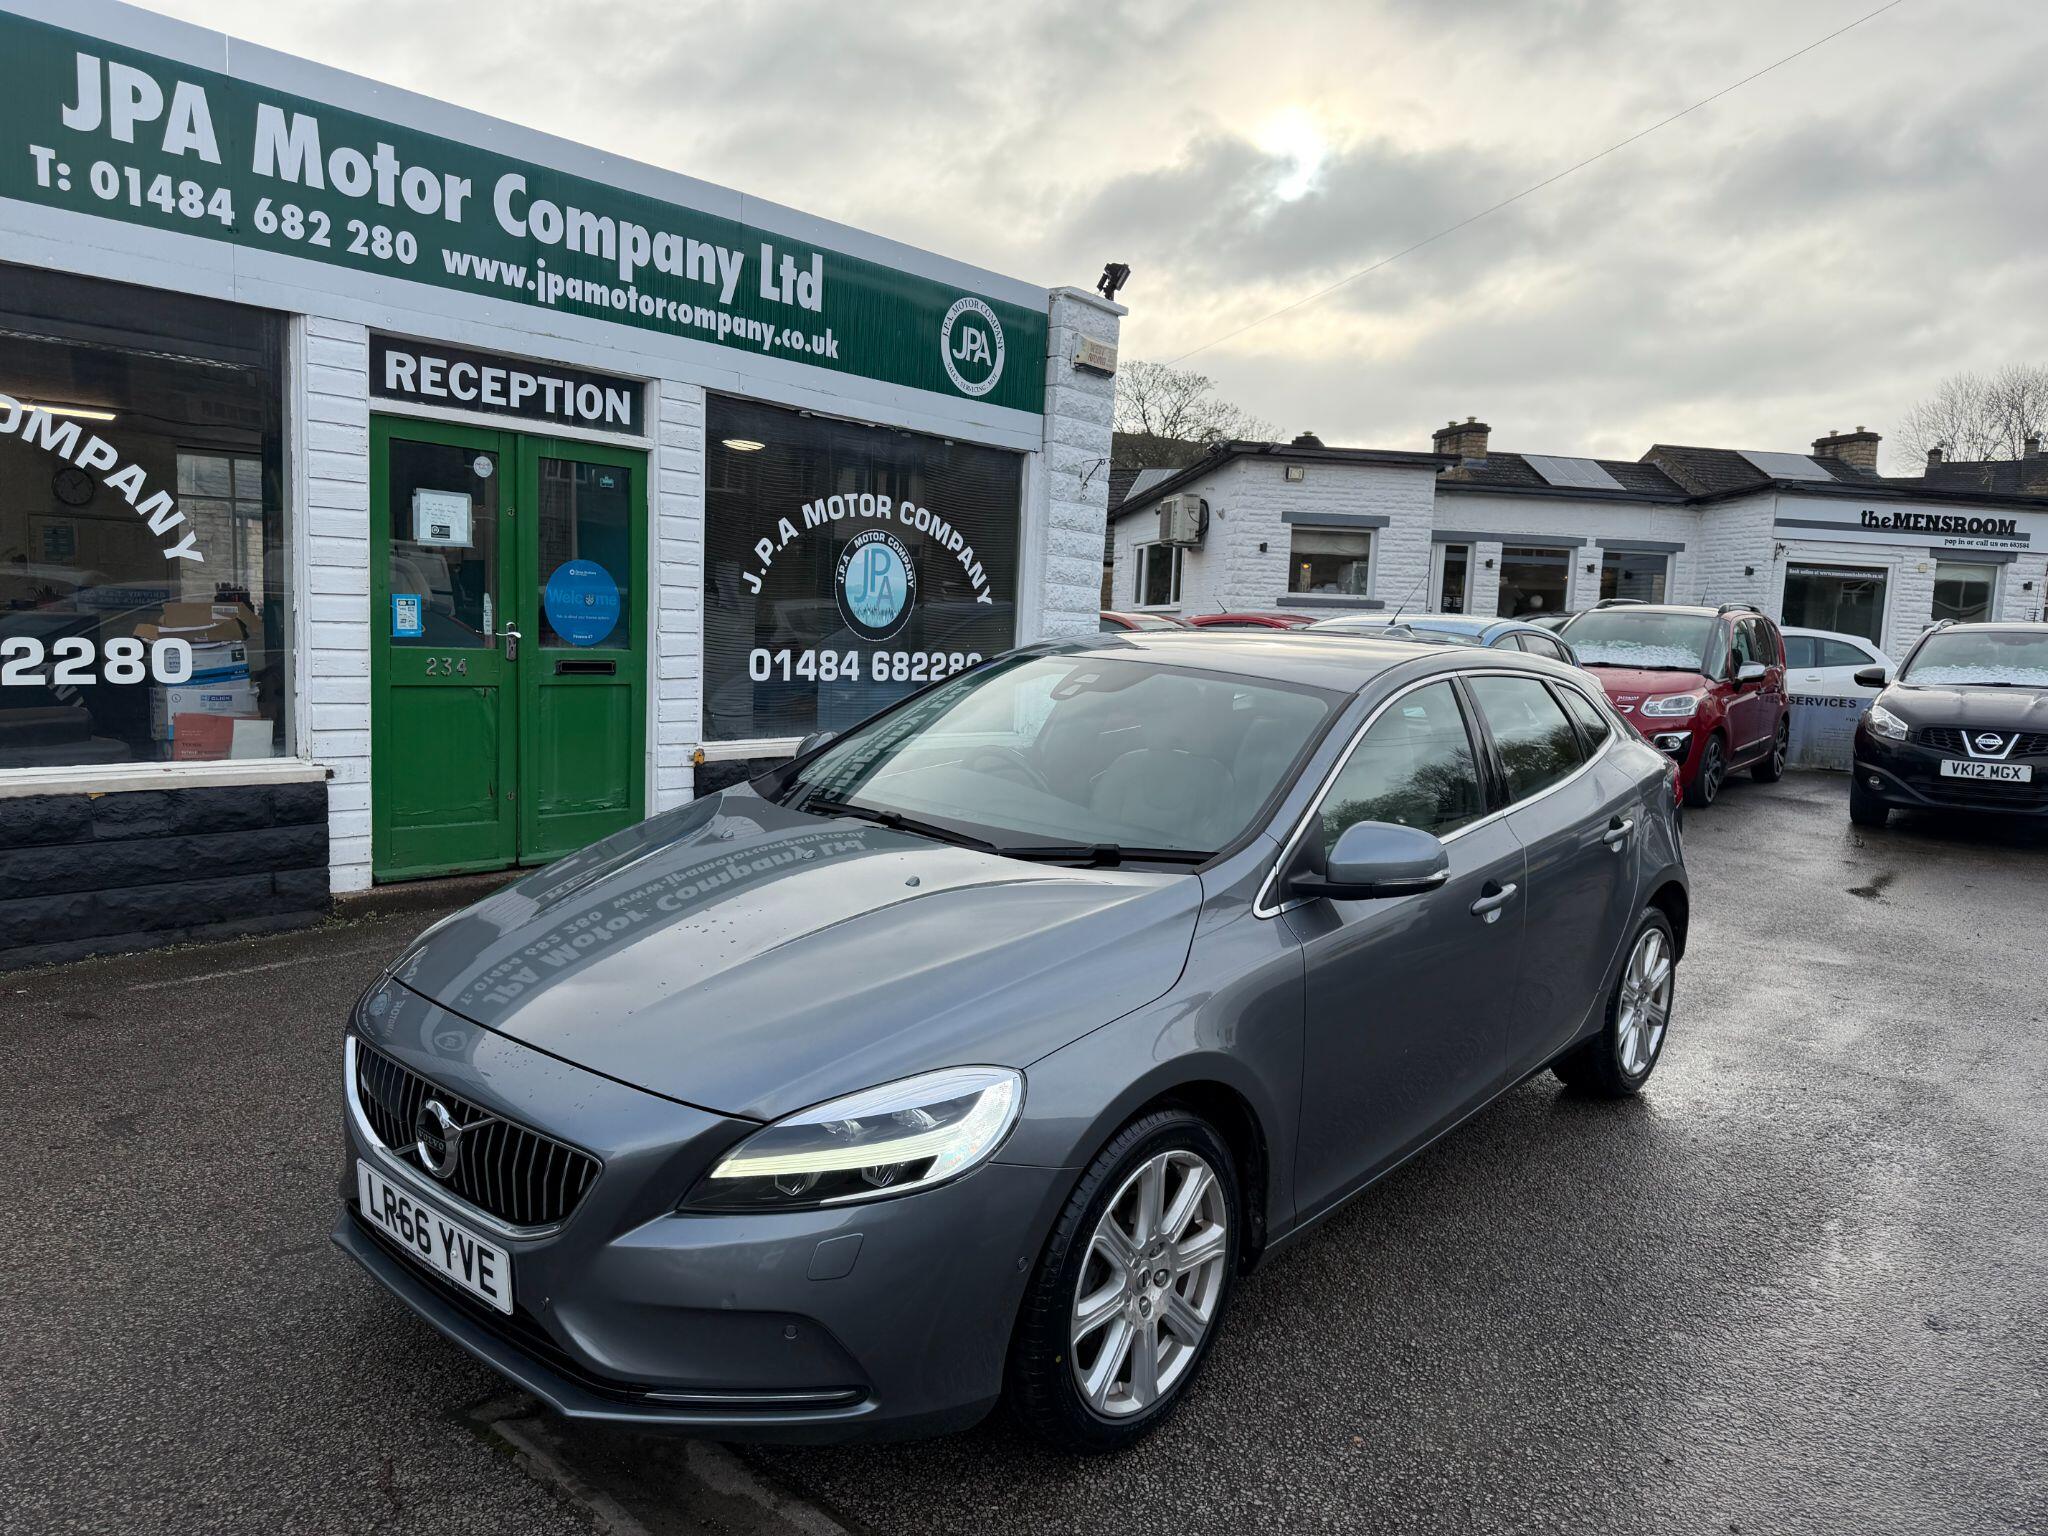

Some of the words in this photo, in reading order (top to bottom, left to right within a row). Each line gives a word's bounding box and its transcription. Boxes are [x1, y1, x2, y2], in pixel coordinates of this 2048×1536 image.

[62, 51, 222, 165] JPA
[251, 102, 472, 222] Motor
[493, 172, 744, 304] Company
[759, 242, 823, 313] Ltd
[29, 143, 72, 192] T:
[90, 159, 235, 226] 01484
[253, 197, 332, 248] 682
[346, 219, 418, 266] 280
[441, 247, 840, 360] www.jpamotorcompany.co.uk
[952, 299, 979, 315] MOTOR
[980, 304, 1003, 352] COMPANY
[952, 325, 993, 367] JPA
[385, 350, 631, 425] RECEPTION
[1861, 510, 2017, 537] theMENSROOM
[1944, 538, 1957, 546] pop
[1976, 538, 1989, 547] call
[742, 516, 799, 596] J.P.A
[801, 493, 892, 529] MOTOR
[899, 501, 993, 606] COMPANY
[853, 532, 886, 549] MOTOR
[887, 537, 914, 588] COMPANY
[853, 548, 894, 607] JPA
[426, 657, 468, 677] 234
[749, 649, 860, 682] 01484
[1788, 696, 1857, 708] SERVICES
[1952, 762, 1986, 777] VK12
[1990, 765, 2022, 779] MGX
[416, 1128, 445, 1151] VOLVO
[367, 1173, 432, 1255] LR66
[438, 1219, 498, 1299] YVE
